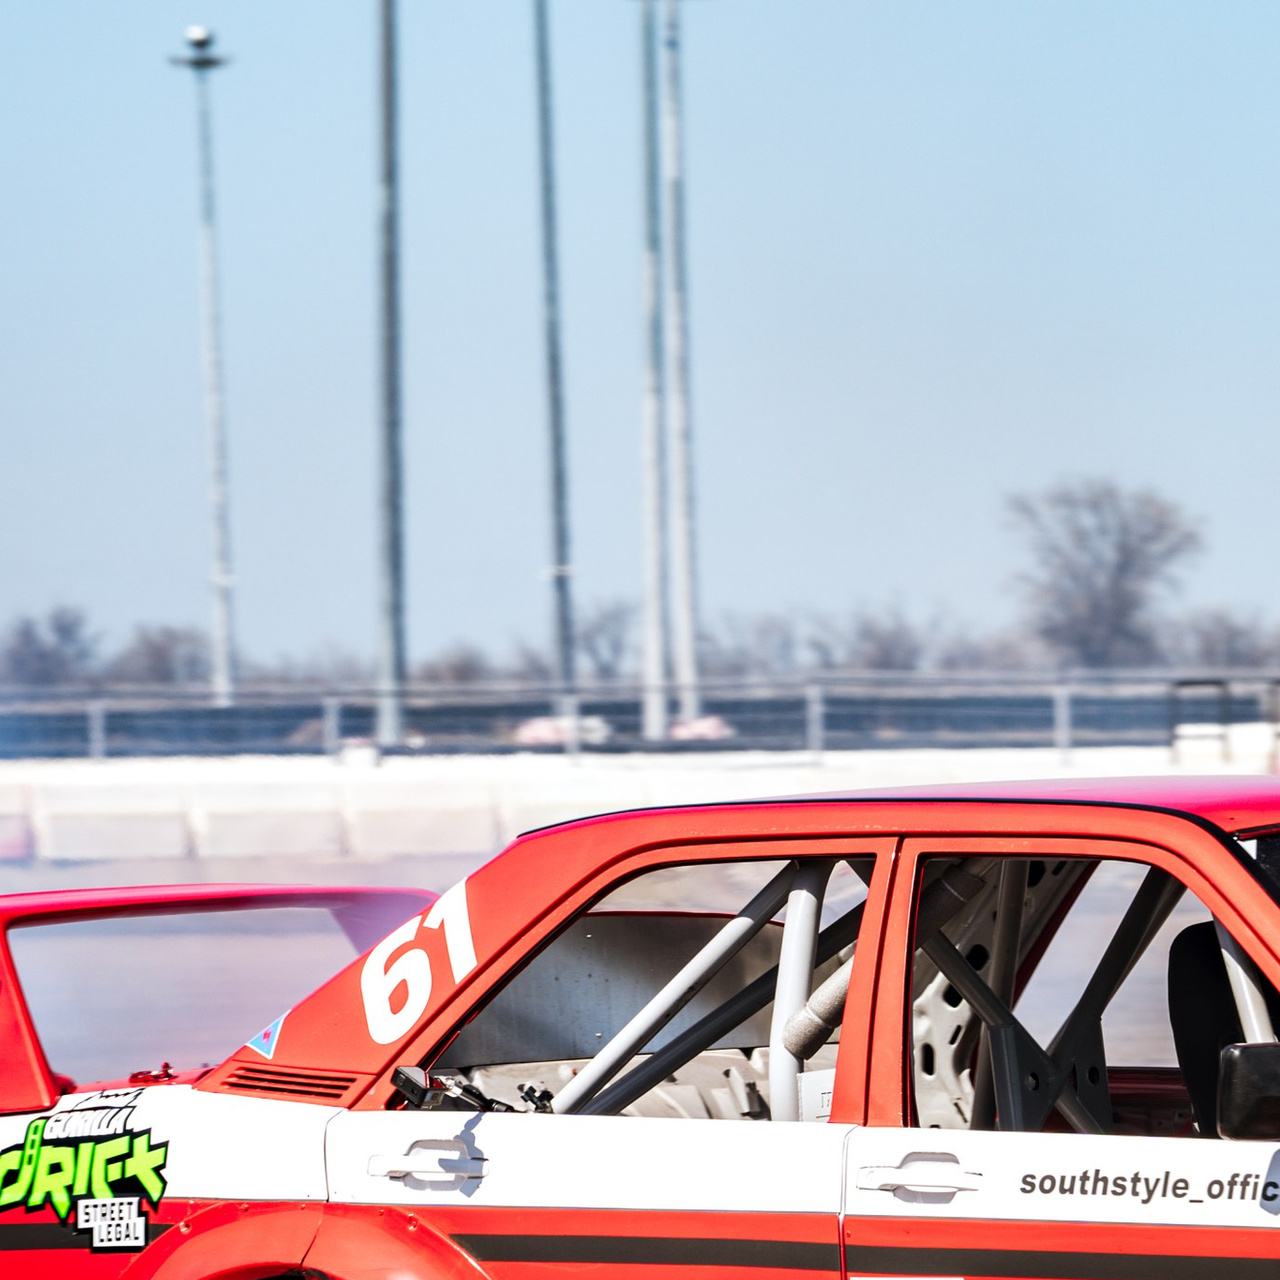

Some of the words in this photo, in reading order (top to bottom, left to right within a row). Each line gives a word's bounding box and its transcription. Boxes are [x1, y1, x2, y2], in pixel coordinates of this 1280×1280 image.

[361, 876, 478, 1045] 61
[84, 1201, 134, 1223] STREET
[98, 1222, 140, 1243] LEGAL
